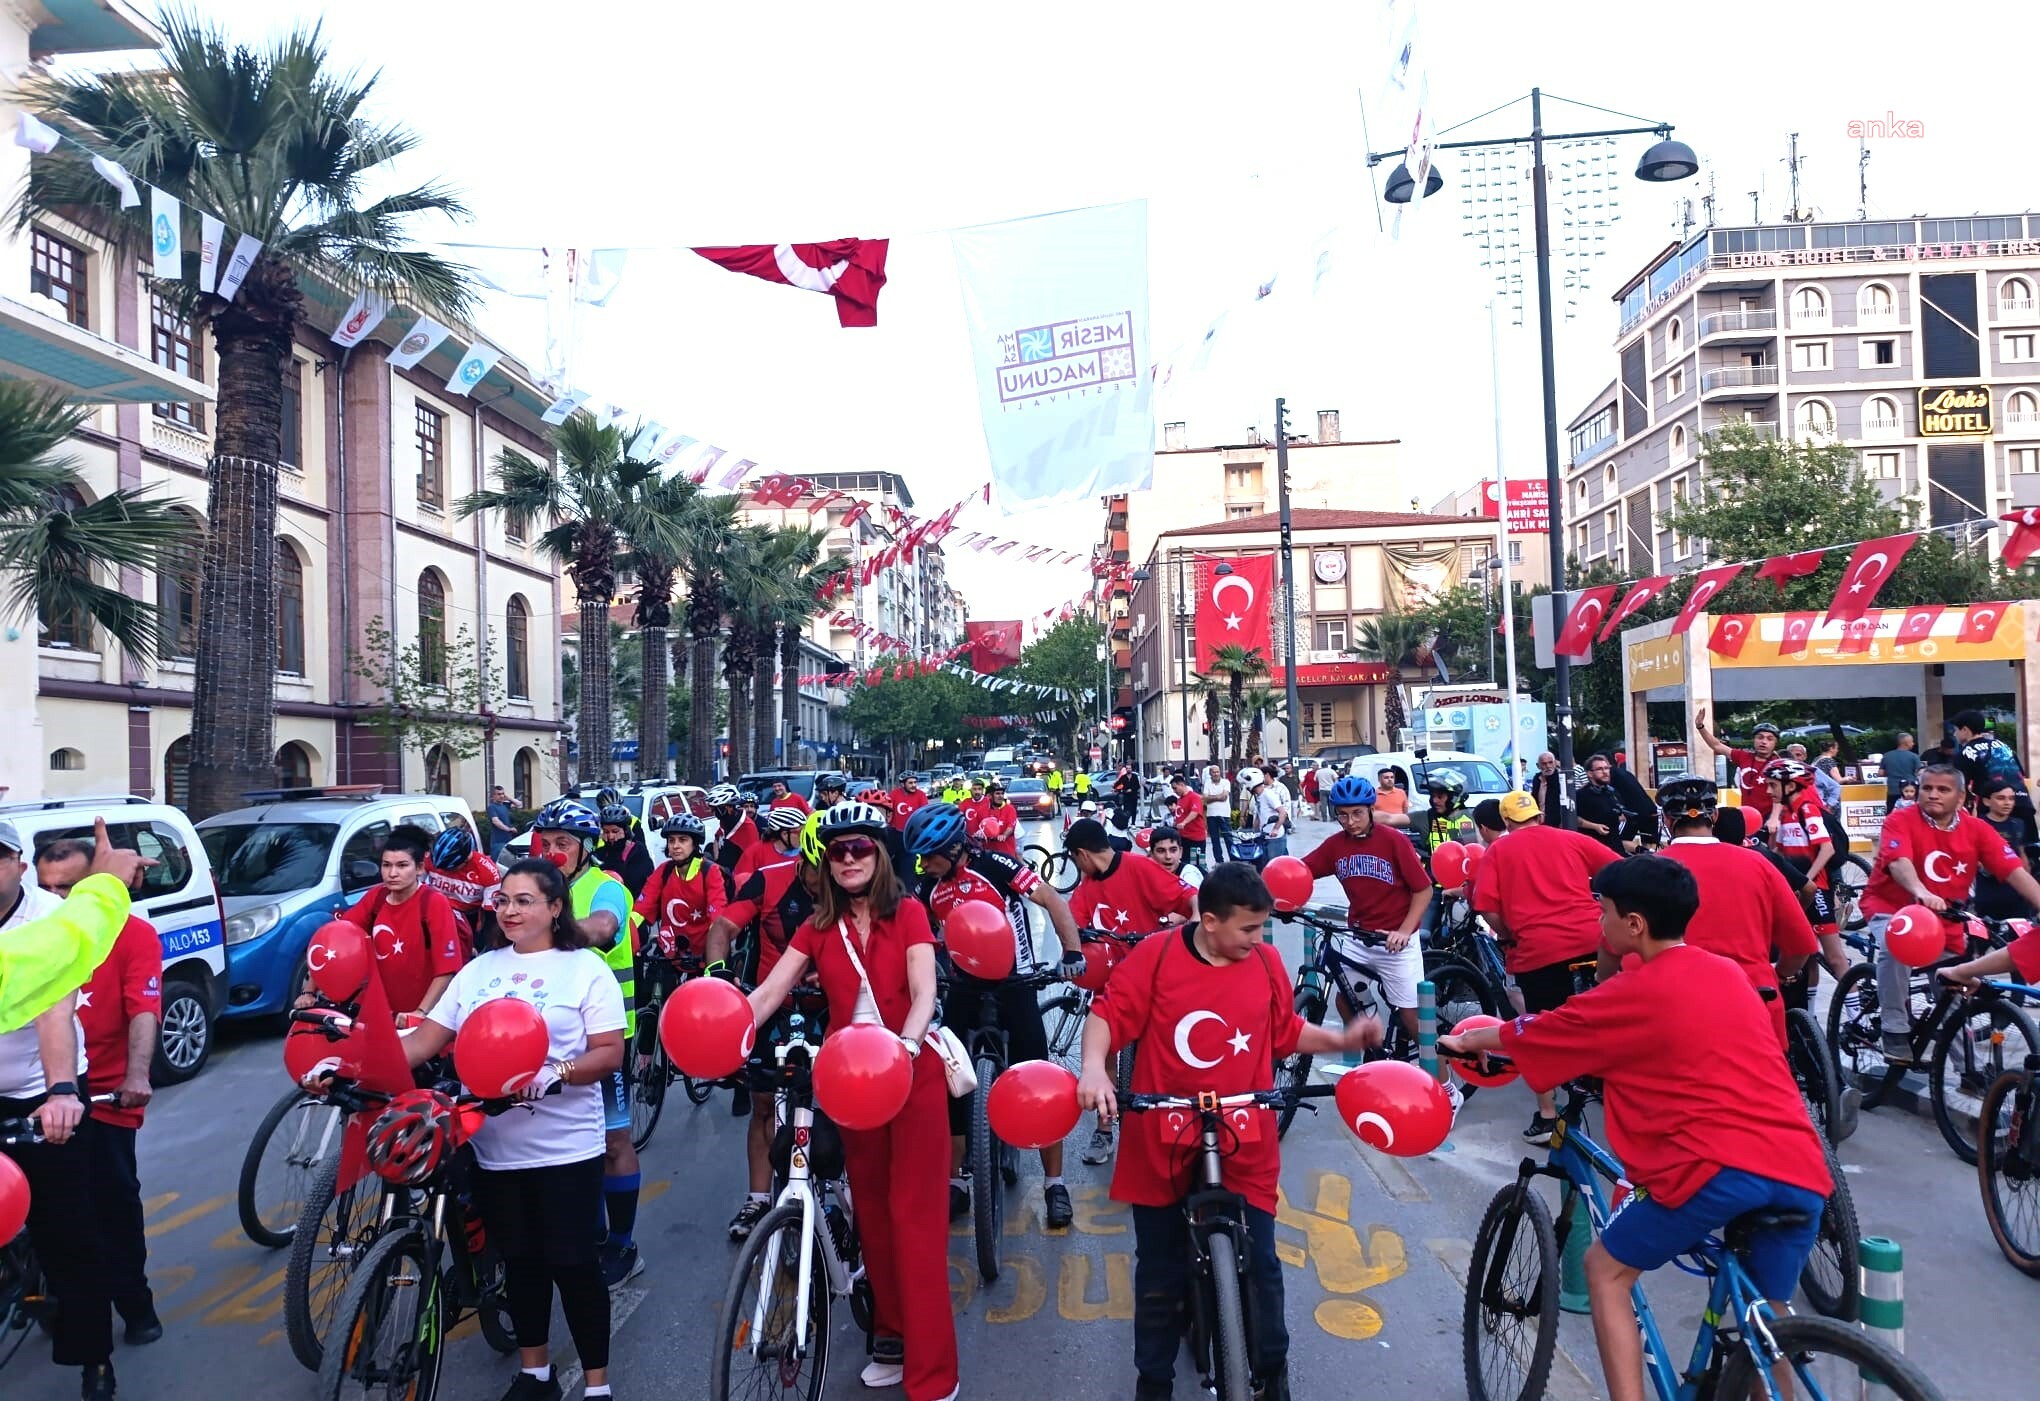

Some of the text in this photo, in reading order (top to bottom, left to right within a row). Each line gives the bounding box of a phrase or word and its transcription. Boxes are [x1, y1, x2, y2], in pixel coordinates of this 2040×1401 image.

[1731, 251, 1790, 268] LOOKS
[1794, 249, 1855, 265] HOTEL
[1923, 389, 1988, 414] Looks
[1925, 413, 1988, 432] HOTEL
[1506, 507, 1531, 519] AHRİ
[479, 856, 501, 881] TÜRKİYE
[1348, 854, 1395, 886] ANGELES
[429, 876, 482, 897] TÜRKİYE
[169, 928, 211, 953] ALO 153
